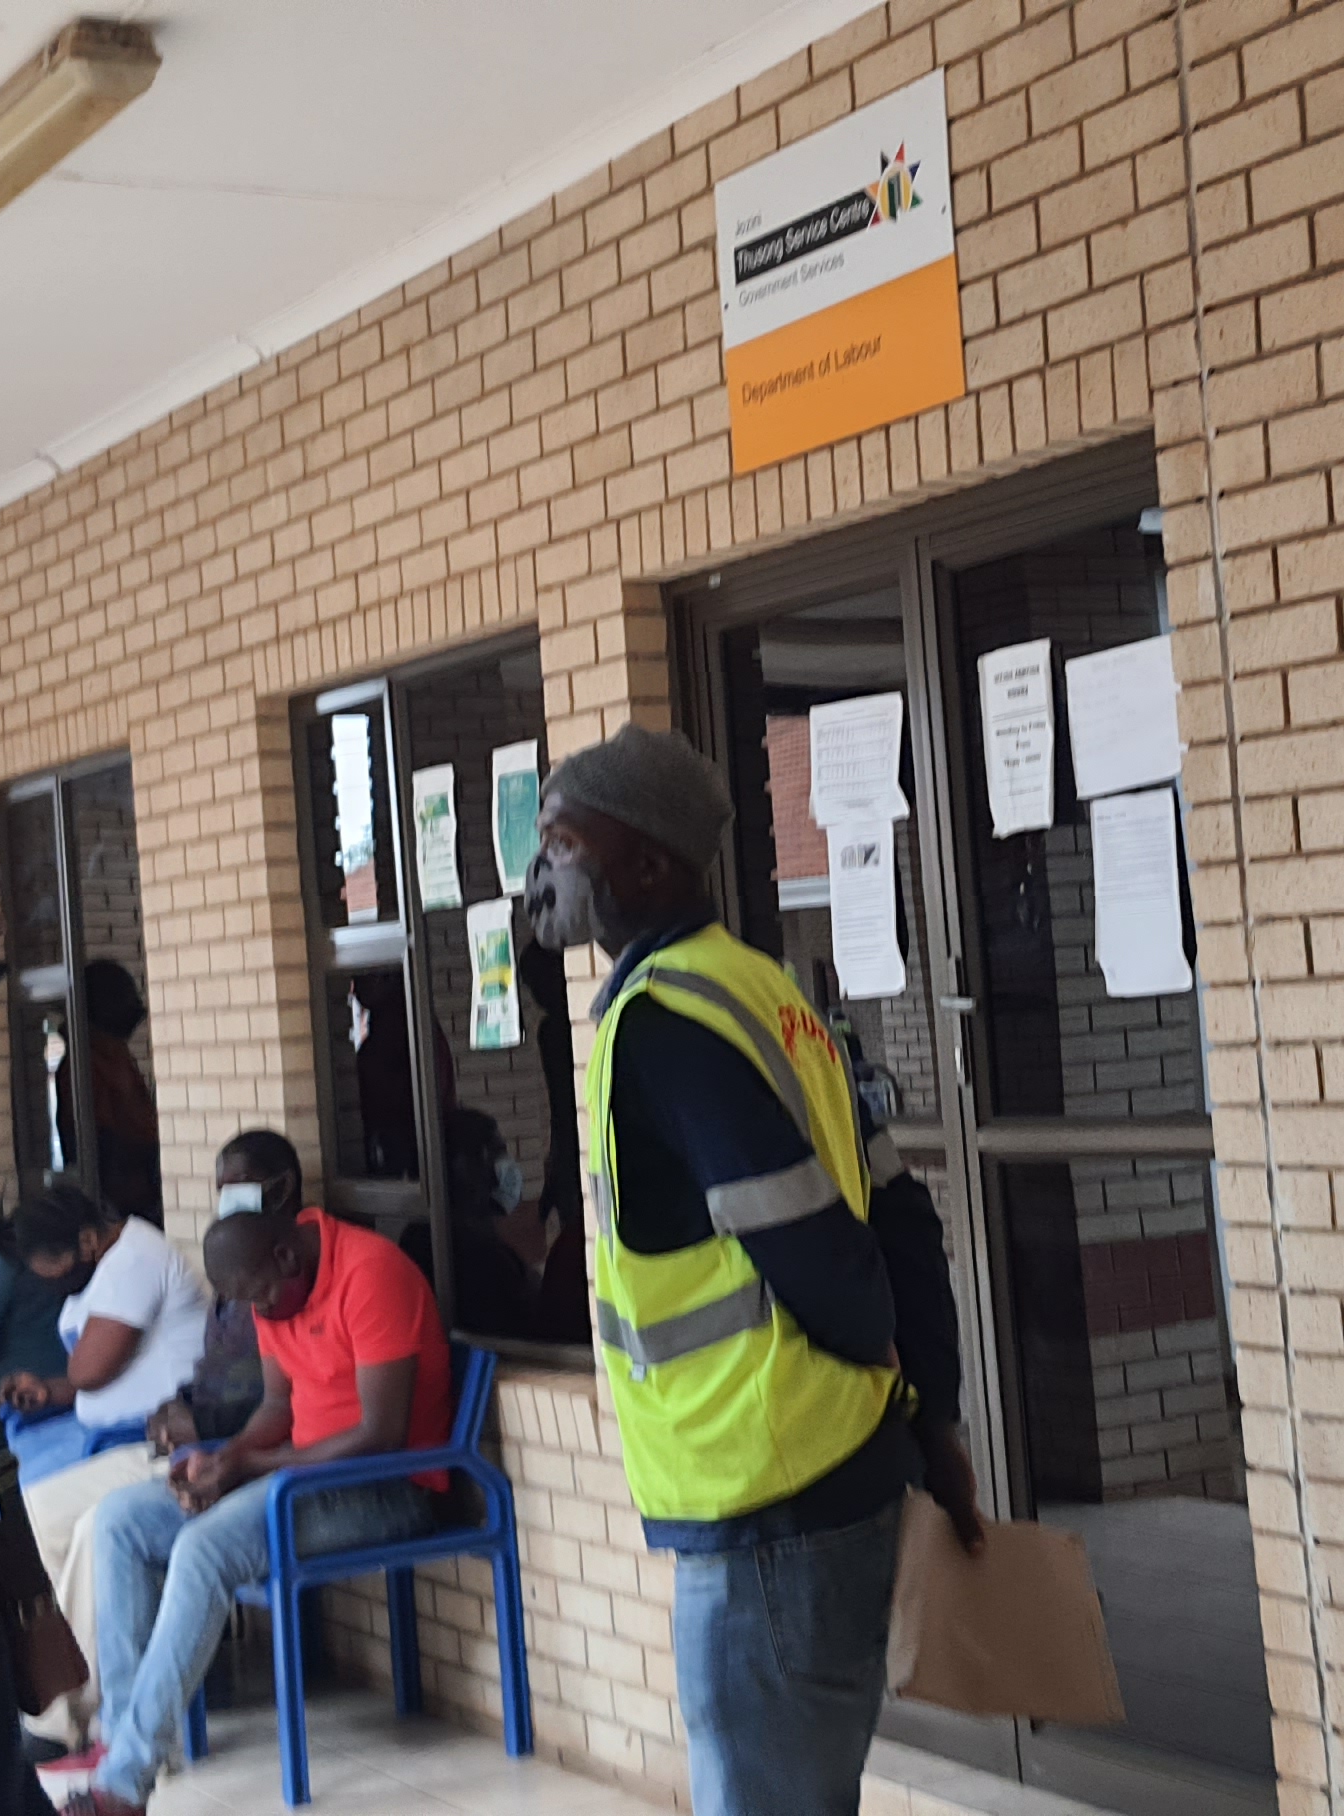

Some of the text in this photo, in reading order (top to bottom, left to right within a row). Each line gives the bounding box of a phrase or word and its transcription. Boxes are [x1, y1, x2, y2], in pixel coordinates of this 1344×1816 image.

[737, 198, 871, 275] Thusong Service Centre
[739, 253, 844, 307] Government Services
[742, 334, 881, 408] Department of Labour
